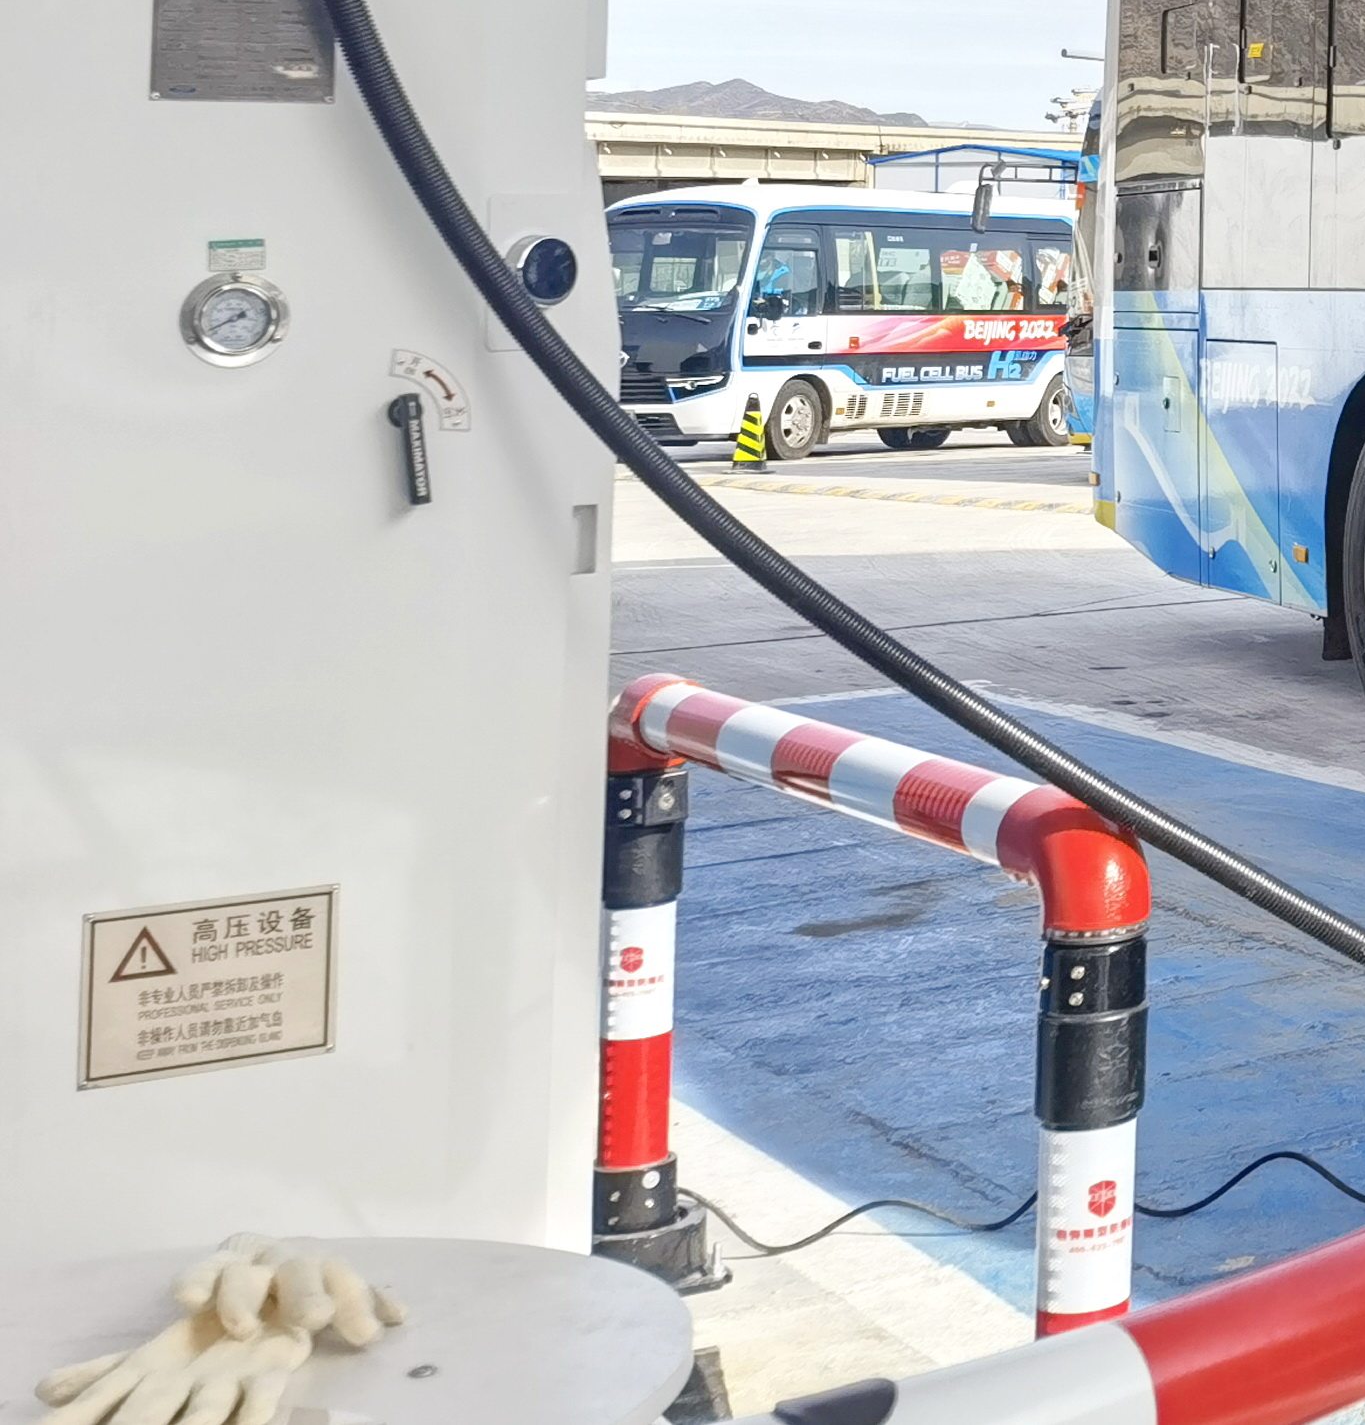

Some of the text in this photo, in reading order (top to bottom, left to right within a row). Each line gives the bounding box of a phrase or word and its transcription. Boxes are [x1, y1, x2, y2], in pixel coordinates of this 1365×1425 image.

[963, 319, 1058, 346] BEIJING 2022
[882, 365, 983, 383] FUEL CELL BUS
[1200, 357, 1317, 414] BEIJING 2022
[191, 906, 318, 945] 高压设备
[191, 932, 315, 965] HIGH PRESSURE
